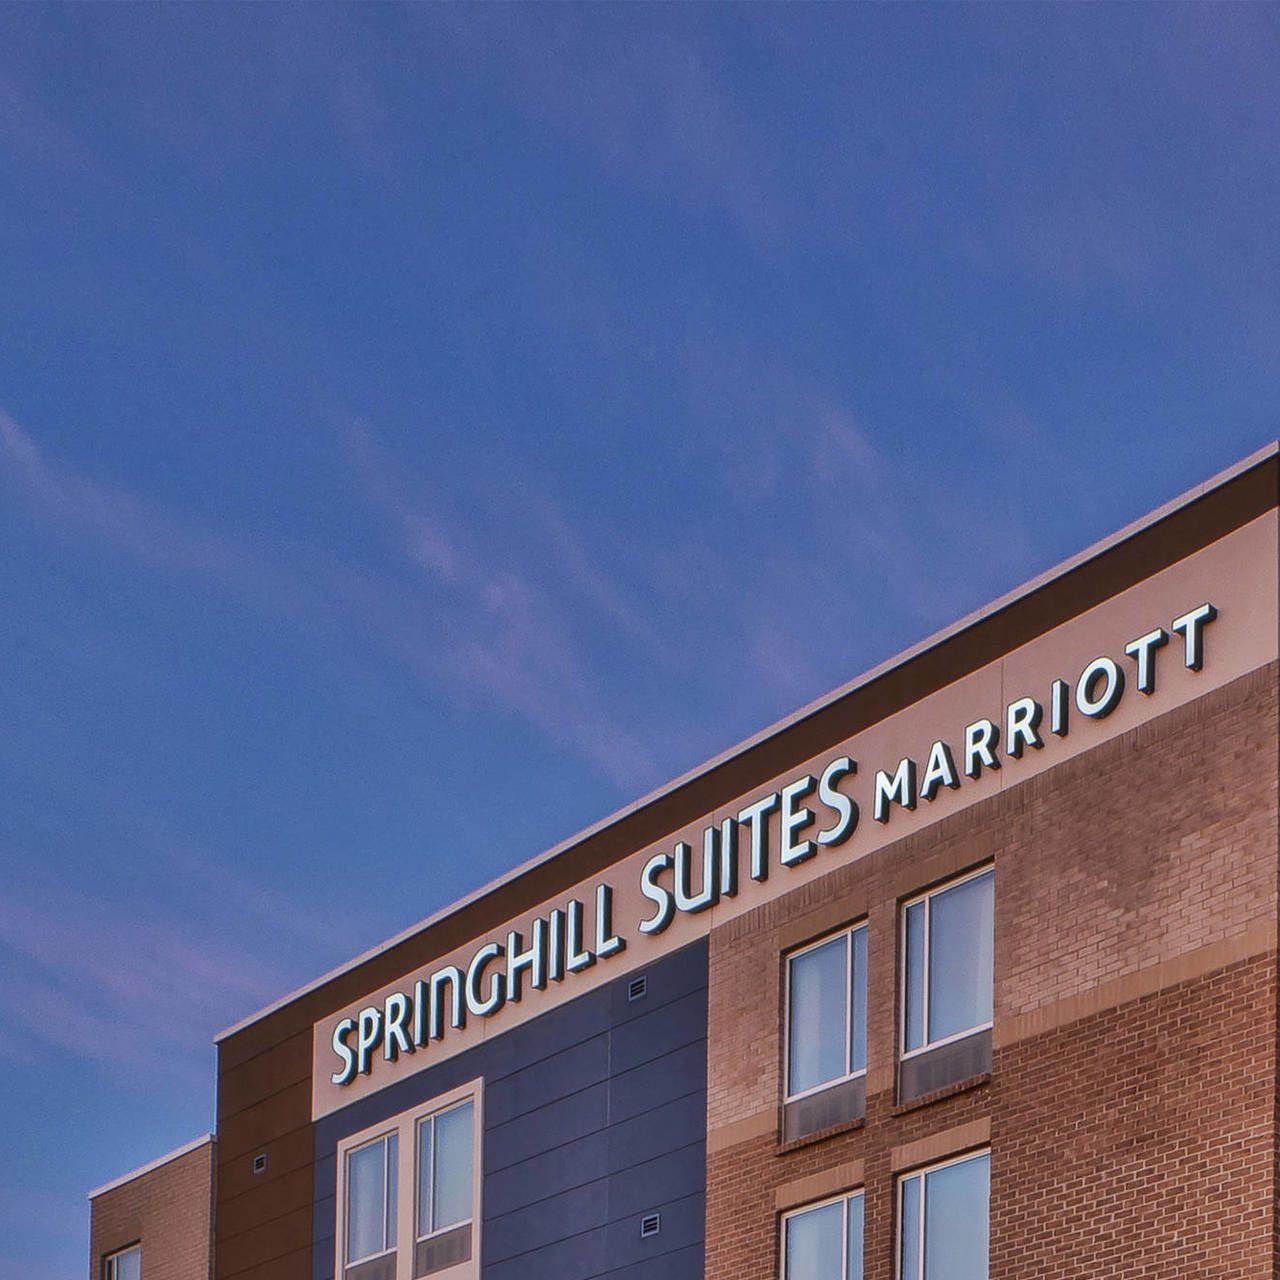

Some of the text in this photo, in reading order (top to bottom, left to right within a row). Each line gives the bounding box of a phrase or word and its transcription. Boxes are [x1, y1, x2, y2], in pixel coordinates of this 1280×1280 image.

[331, 602, 1217, 1085] SPRINGHILL SUITES MARRIOTT
